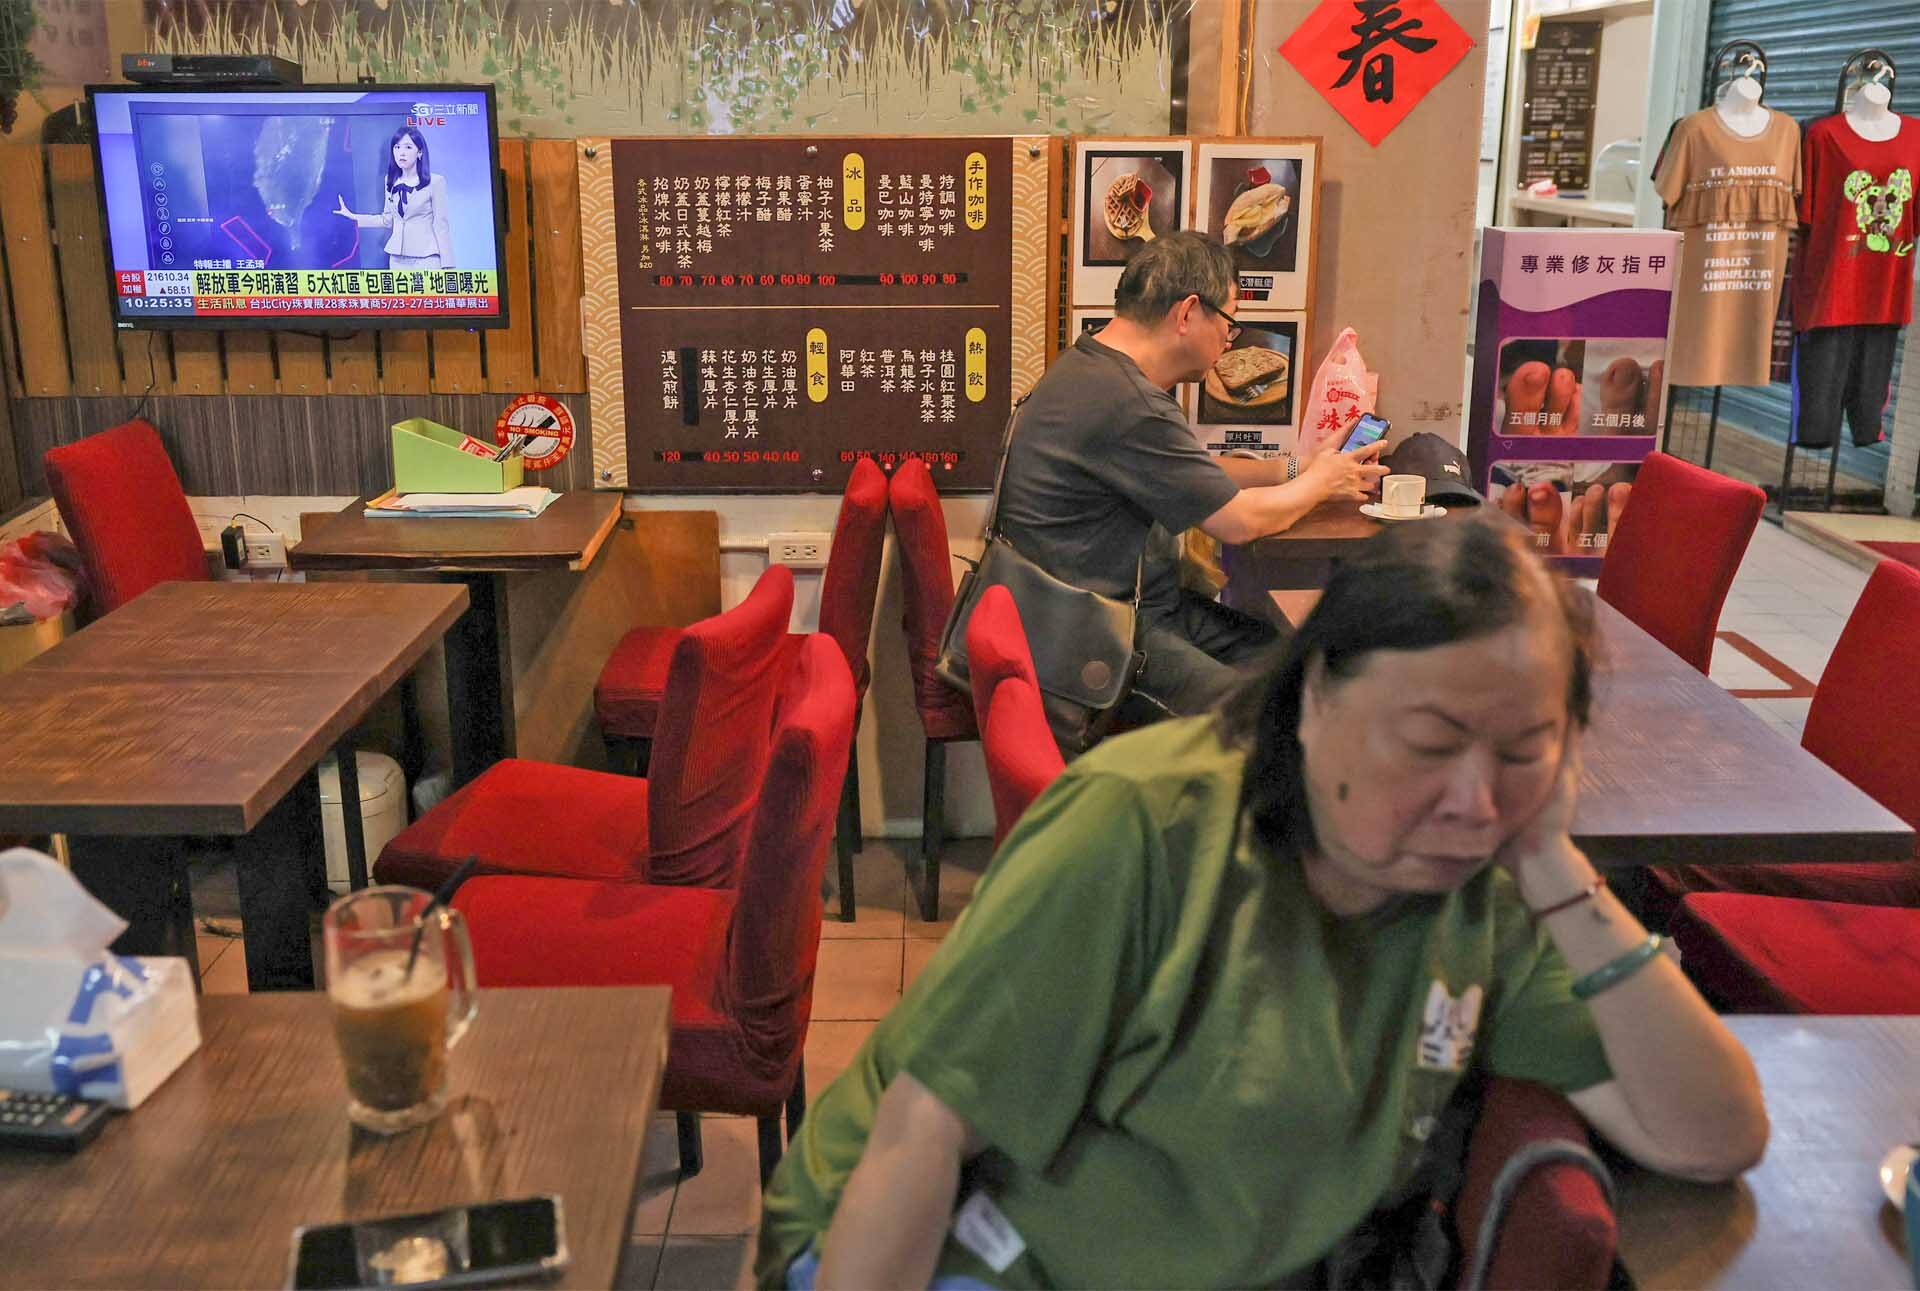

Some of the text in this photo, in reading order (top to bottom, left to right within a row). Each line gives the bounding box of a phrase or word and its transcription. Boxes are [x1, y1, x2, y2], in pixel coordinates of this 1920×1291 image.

[1330, 0, 1437, 104] 春
[407, 116, 447, 126] LIVE
[434, 103, 479, 115] 三立新聞
[714, 175, 733, 238] 檸檬紅茶
[735, 175, 752, 222] 檸檬汁
[755, 175, 773, 222] 梅子醋
[776, 175, 793, 222] 蘋果醋
[797, 175, 814, 222] 蛋蜜汁
[846, 166, 863, 213] 冰品
[878, 174, 894, 237] 曼巴咖啡
[898, 174, 915, 237] 藍山咖啡
[918, 174, 935, 252] 曼特寧咖啡
[939, 174, 956, 237] 特調咖啡
[967, 160, 984, 223] 手作咖啡
[653, 176, 672, 254] 招牌冰咖啡
[673, 176, 693, 269] 奶蓋日式抹茶
[817, 175, 834, 253] 柚子水果茶
[121, 273, 142, 283] 台股
[147, 273, 190, 283] 21610.34
[196, 272, 299, 295] 解放軍今明演習
[680, 275, 693, 287] 70
[701, 274, 716, 286] 70
[739, 274, 754, 286] 70
[760, 274, 775, 286] 60
[818, 274, 836, 286] 100
[901, 272, 918, 284] 100
[922, 273, 937, 284] 90
[1520, 255, 1666, 275] 專業修灰指甲
[126, 298, 193, 308] 10:25:35
[167, 286, 191, 295] 58.51
[198, 297, 247, 309] 生活訊息
[701, 350, 719, 409] 蒜味厚片
[762, 350, 778, 409] 花生厚片
[781, 350, 798, 409] 奶油厚片
[809, 341, 826, 386] 輕食
[840, 349, 855, 392] 阿華田
[860, 349, 876, 378] 紅茶
[880, 349, 896, 393] 普洱茶
[900, 349, 916, 393] 烏龍茶
[920, 349, 936, 423] 柚子水果茶
[939, 349, 956, 423] 桂圓紅棗茶
[967, 341, 984, 386] 熱飲
[721, 350, 739, 439] 花生杏仁厚片
[741, 350, 759, 439] 奶油杏仁厚片
[524, 426, 559, 437] SMOKING
[1509, 412, 1561, 426] 五個月前
[1591, 413, 1645, 428] 五個月後
[661, 450, 681, 462] 120
[743, 451, 760, 463] 50
[840, 452, 855, 462] 60
[1577, 533, 1608, 547] 五個
